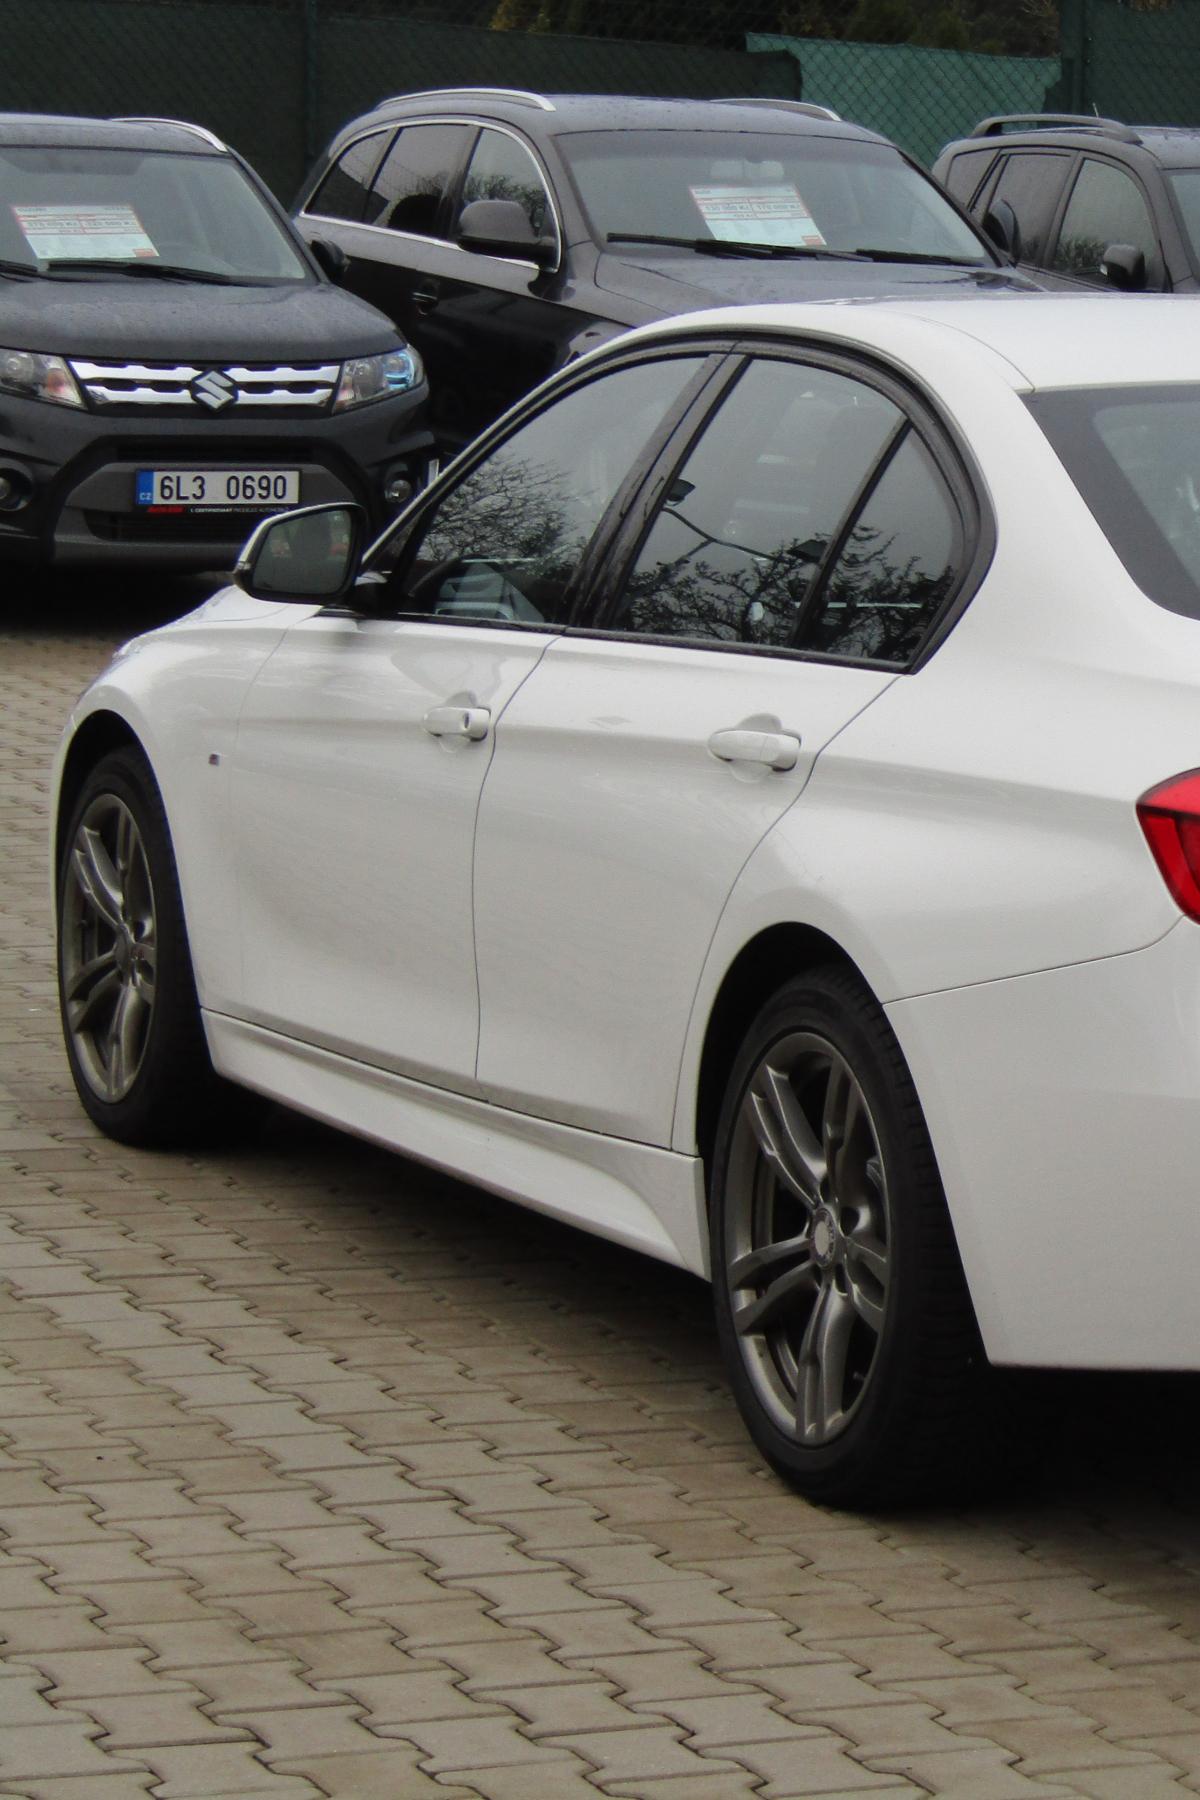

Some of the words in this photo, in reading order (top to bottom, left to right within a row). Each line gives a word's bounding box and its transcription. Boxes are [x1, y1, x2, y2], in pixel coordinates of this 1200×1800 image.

[160, 475, 206, 500] 6L3
[226, 475, 287, 500] 0690
[139, 492, 152, 500] CZ
